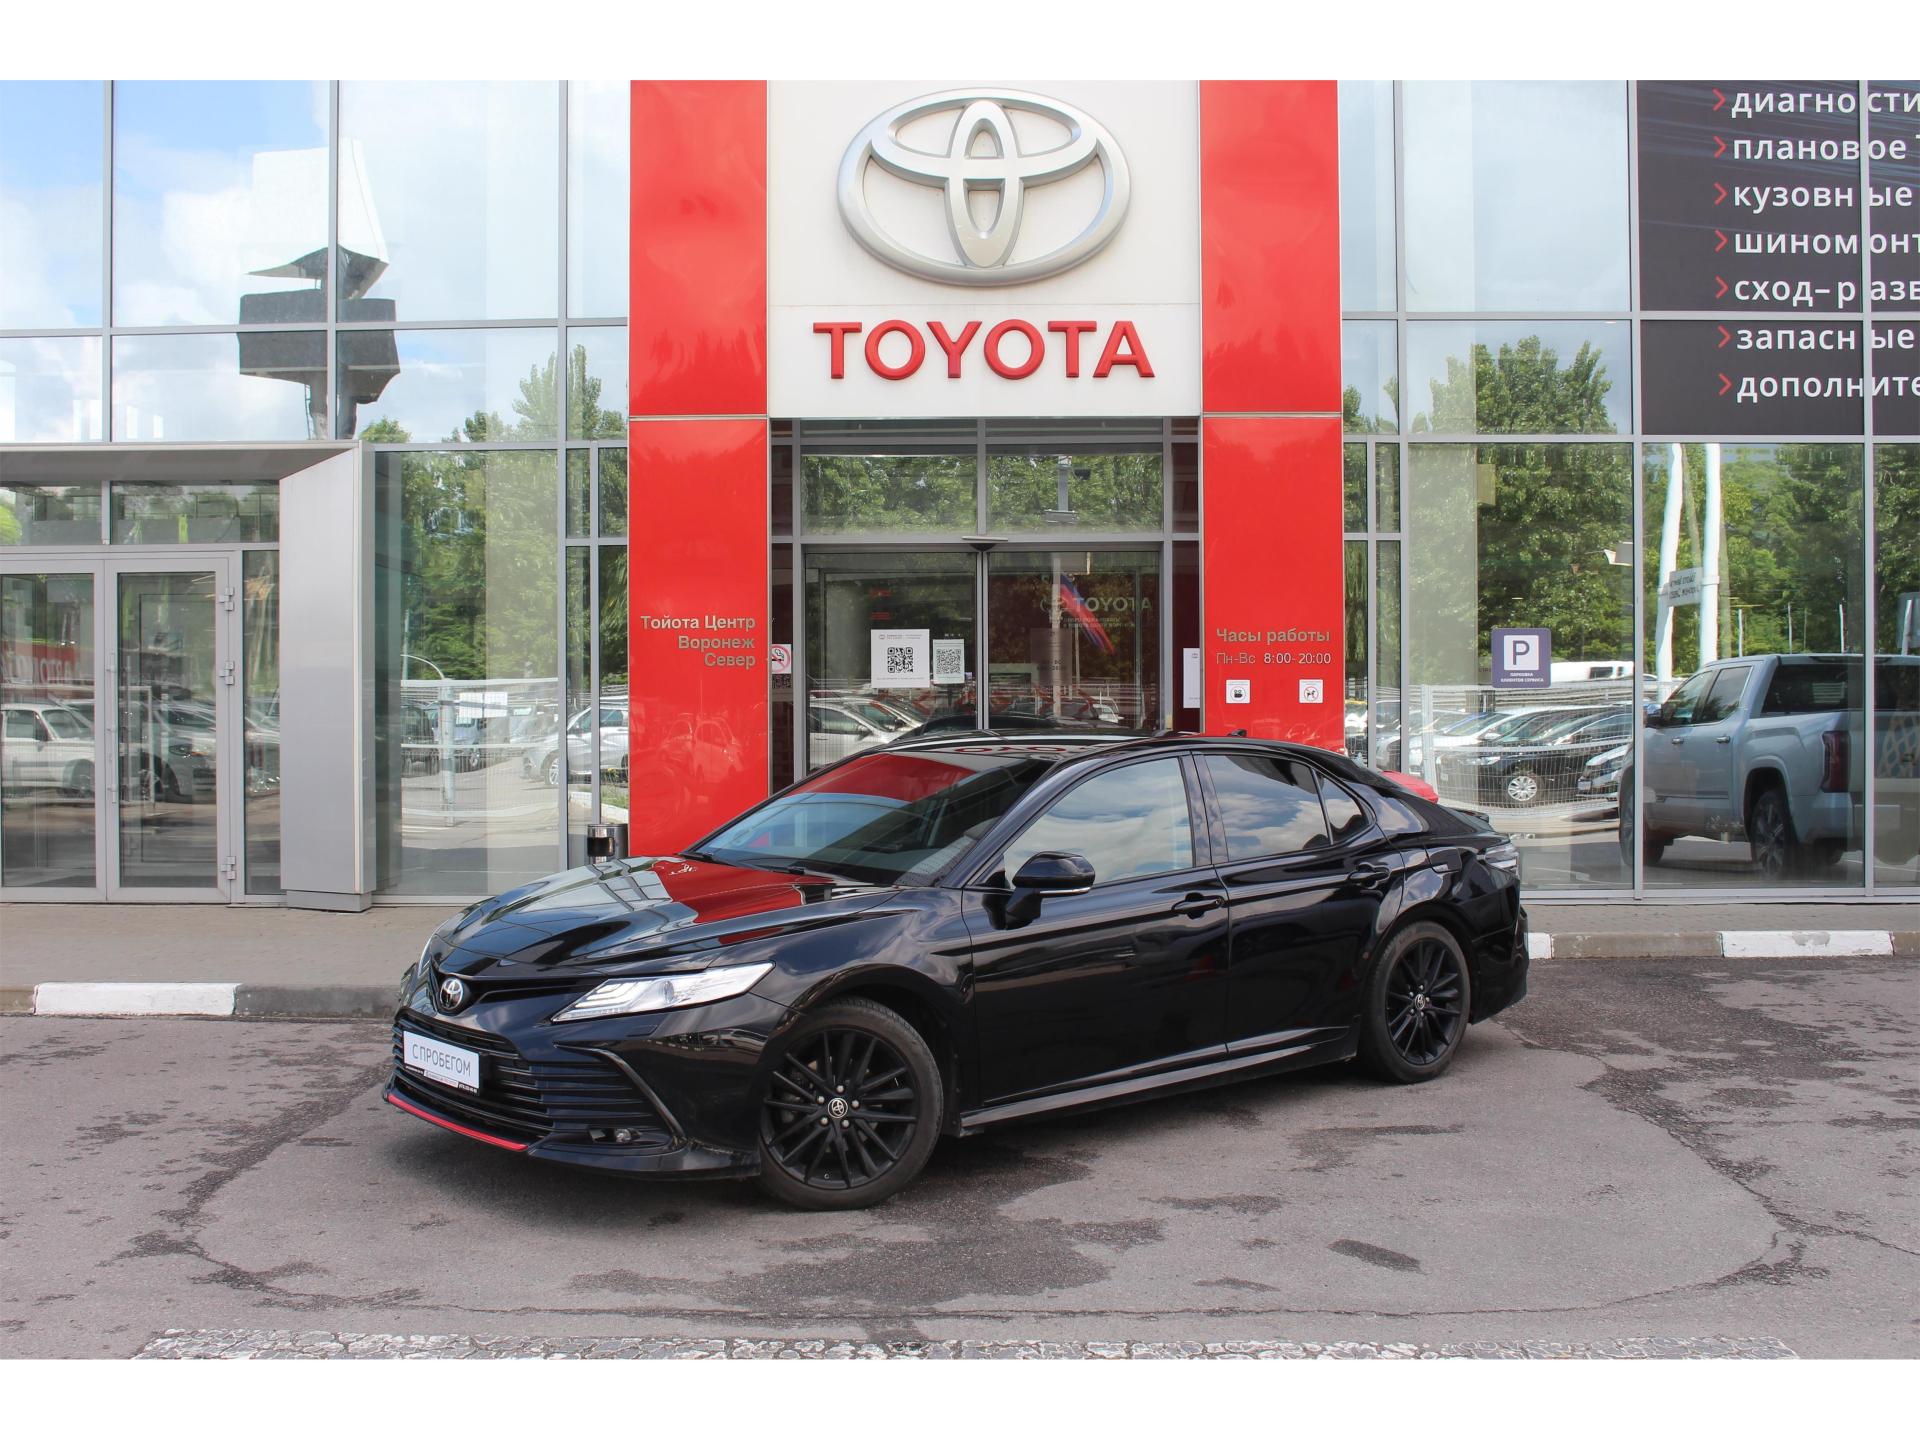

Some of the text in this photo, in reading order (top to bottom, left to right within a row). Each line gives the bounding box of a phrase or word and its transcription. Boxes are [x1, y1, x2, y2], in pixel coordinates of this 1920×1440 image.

[1733, 139, 1907, 160] плановое
[1734, 186, 1913, 214] кузовные
[1736, 328, 1915, 350] запасные
[813, 319, 1155, 381] TOYOTA
[640, 614, 756, 632] Тойота Центр
[678, 635, 755, 652] Воронеж
[1216, 628, 1331, 645] Часы работы
[704, 653, 756, 670] Север
[1216, 653, 1256, 665] Пн-Вс
[1513, 640, 1529, 665] P
